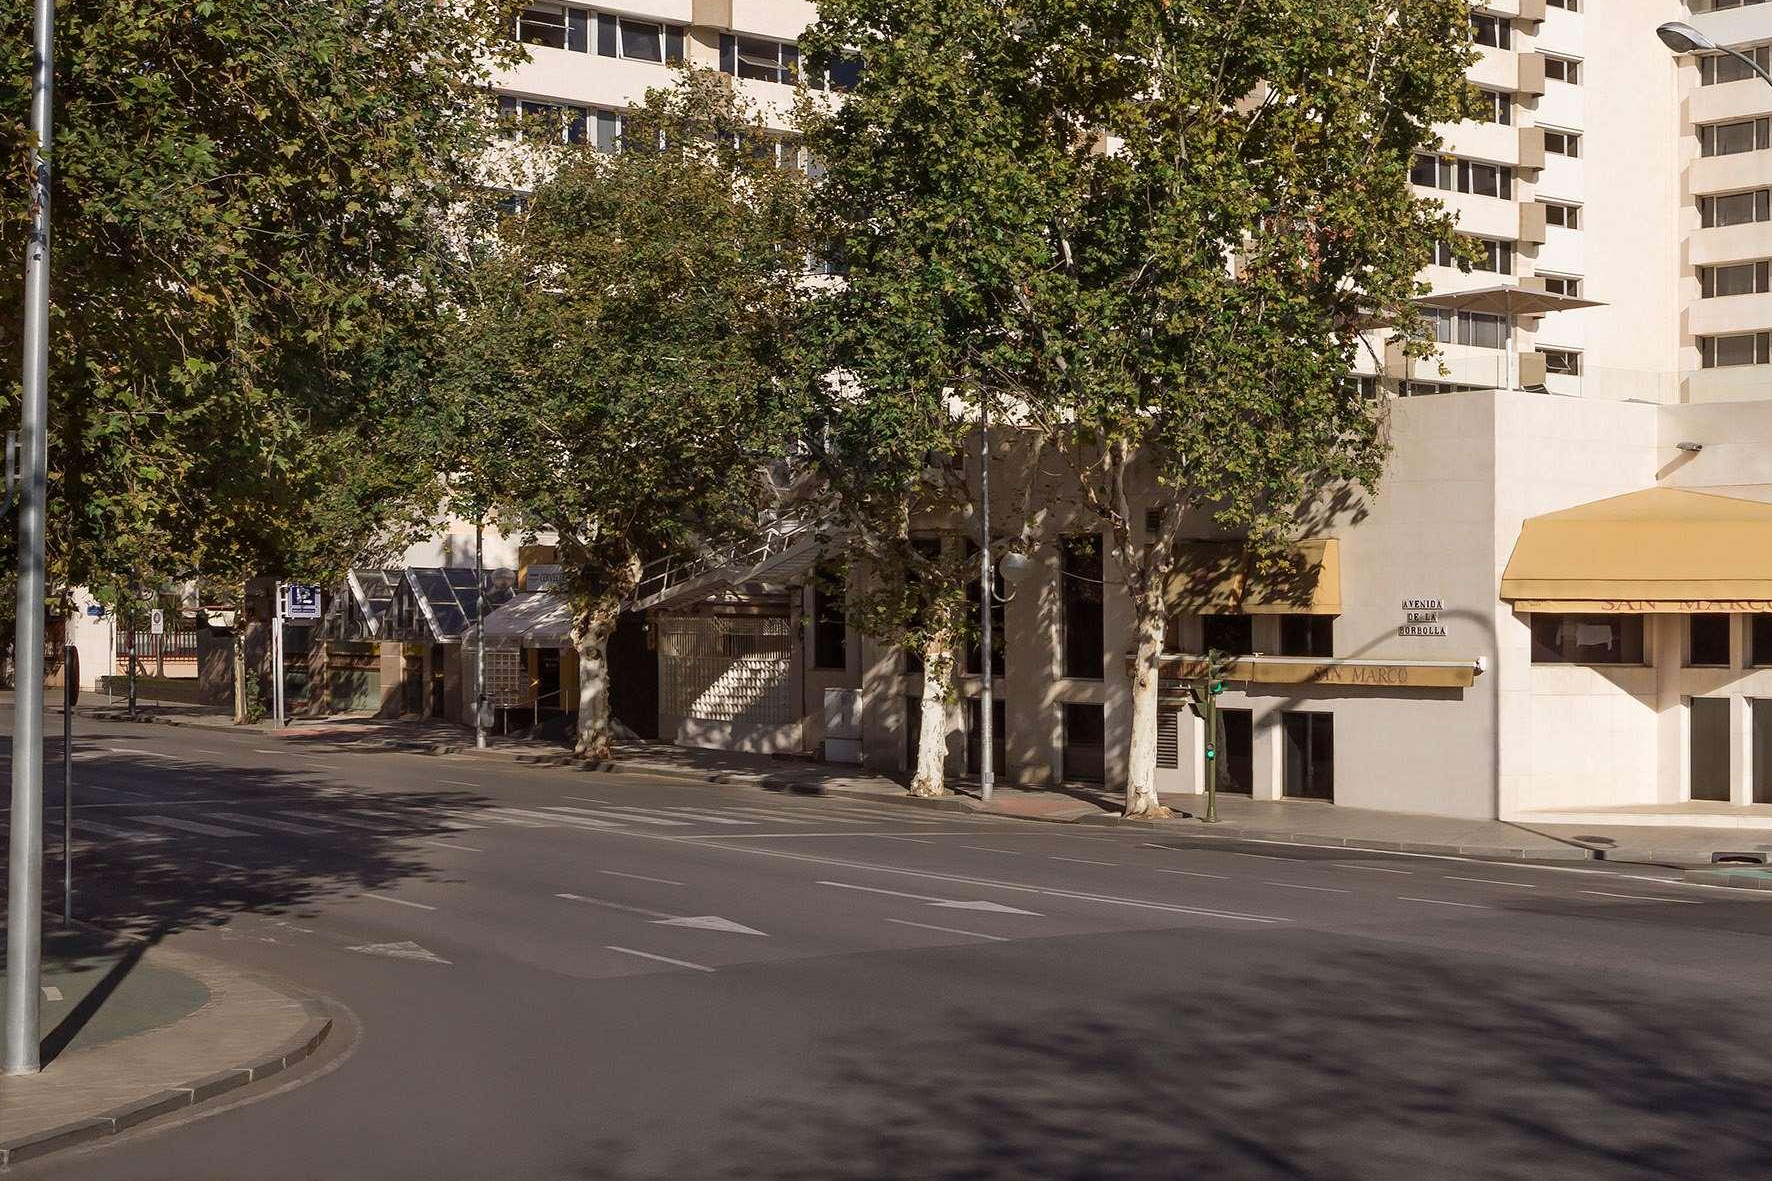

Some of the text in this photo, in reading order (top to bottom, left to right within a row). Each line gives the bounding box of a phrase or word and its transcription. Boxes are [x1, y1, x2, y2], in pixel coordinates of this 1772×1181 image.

[1408, 612, 1438, 621] DE LA
[1399, 626, 1447, 636] BORBOLLA
[1352, 665, 1408, 685] MARCO
